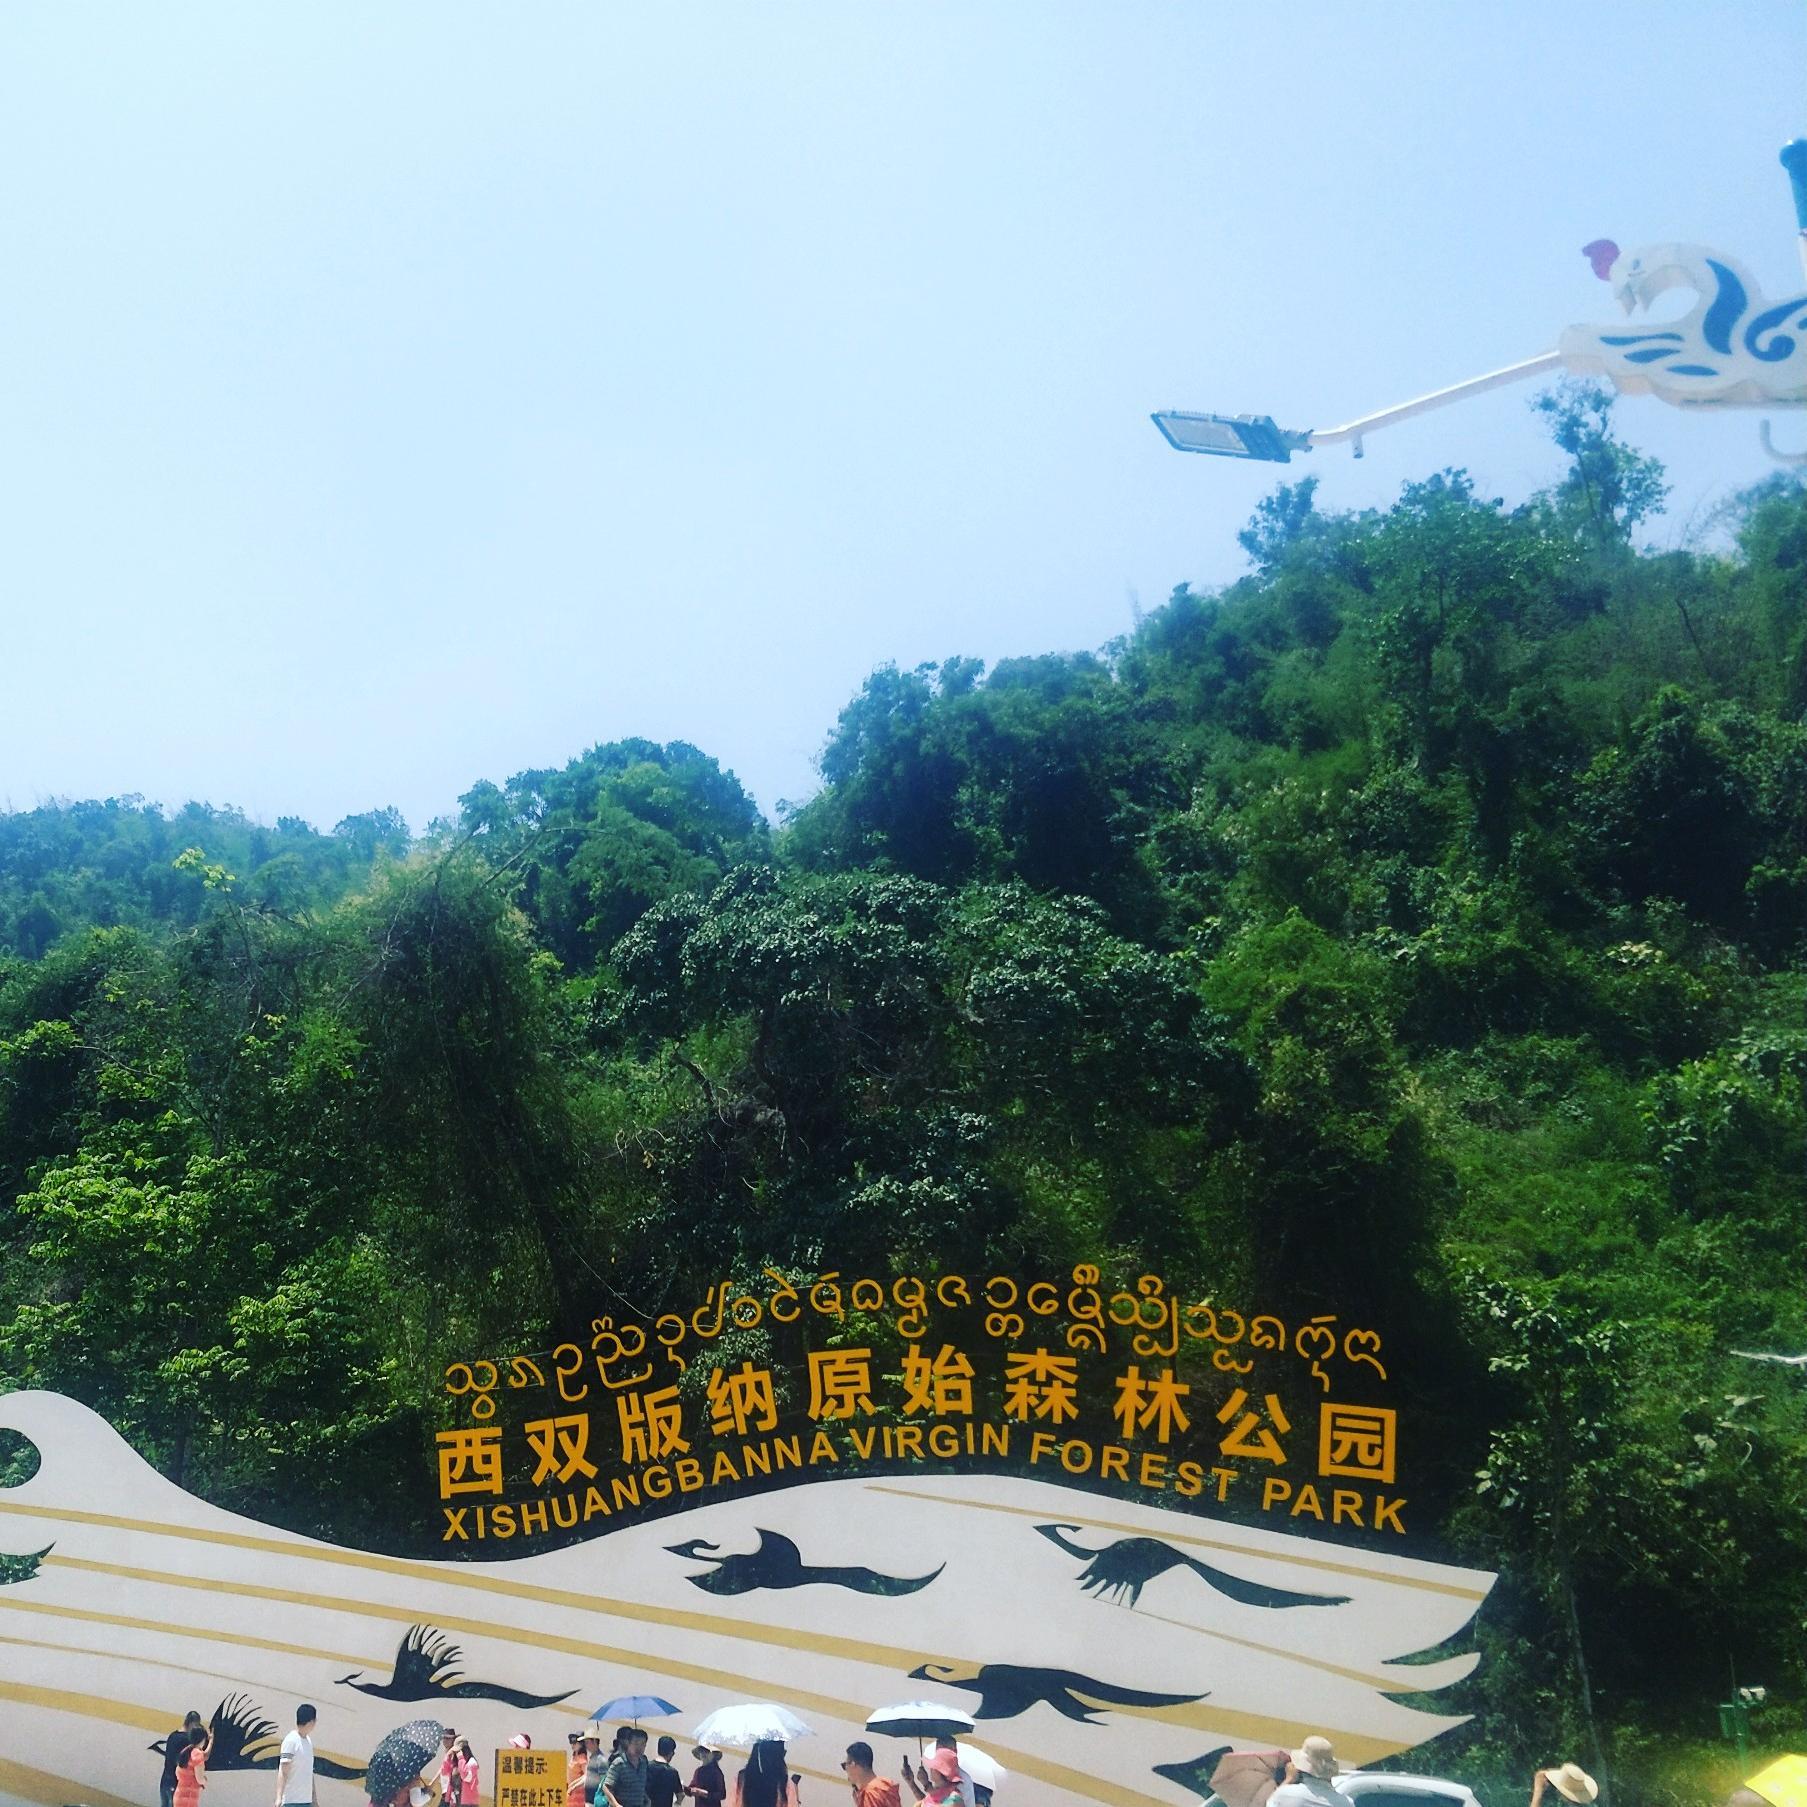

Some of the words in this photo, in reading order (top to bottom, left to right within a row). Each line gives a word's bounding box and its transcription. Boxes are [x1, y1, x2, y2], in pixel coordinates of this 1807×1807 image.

[435, 1344, 1396, 1499] 西双版纳原始森林公园
[443, 1427, 838, 1541] XISHUANGBANNA
[849, 1423, 1009, 1459] VIRGIN
[1030, 1432, 1238, 1501] FOREST
[1262, 1477, 1407, 1534] PARK
